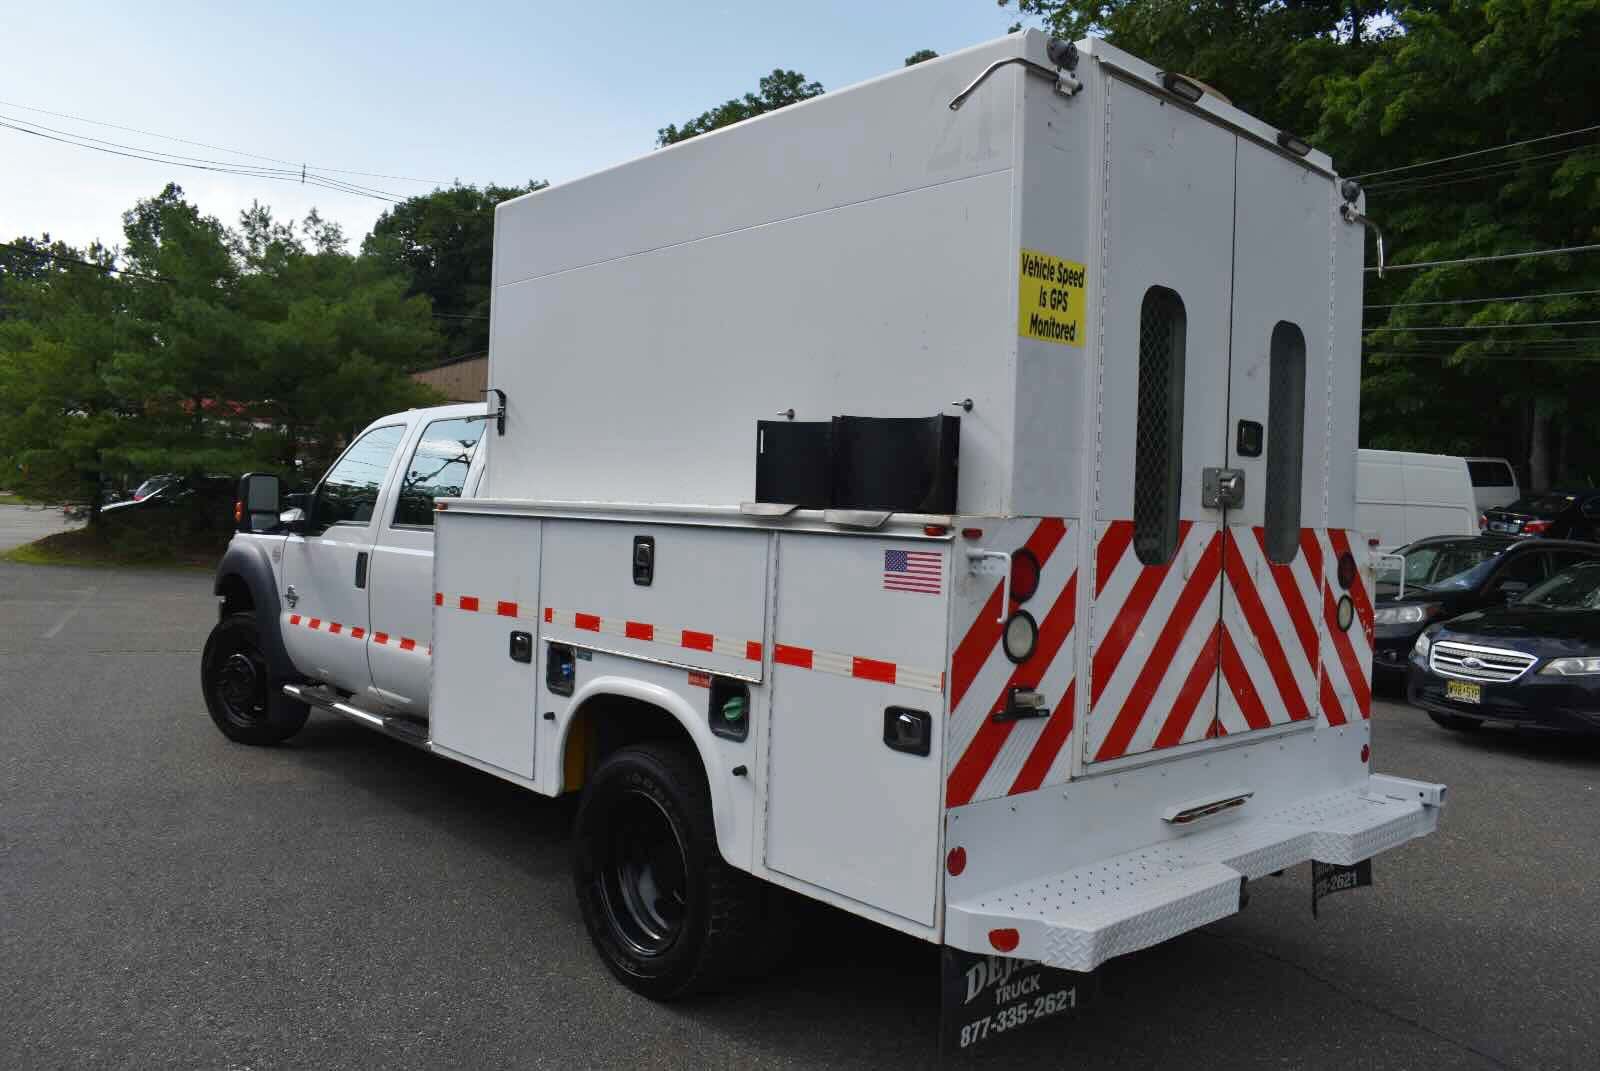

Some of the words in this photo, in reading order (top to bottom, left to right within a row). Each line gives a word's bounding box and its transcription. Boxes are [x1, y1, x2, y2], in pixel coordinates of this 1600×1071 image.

[1021, 253, 1055, 282] Vehicle
[1057, 262, 1085, 288] Speed
[1039, 286, 1047, 308] Is
[1050, 288, 1068, 312] GPS
[1029, 313, 1076, 342] Monitored
[995, 973, 1041, 1005] TRUCK
[960, 984, 1077, 1048] 877-335-2621
